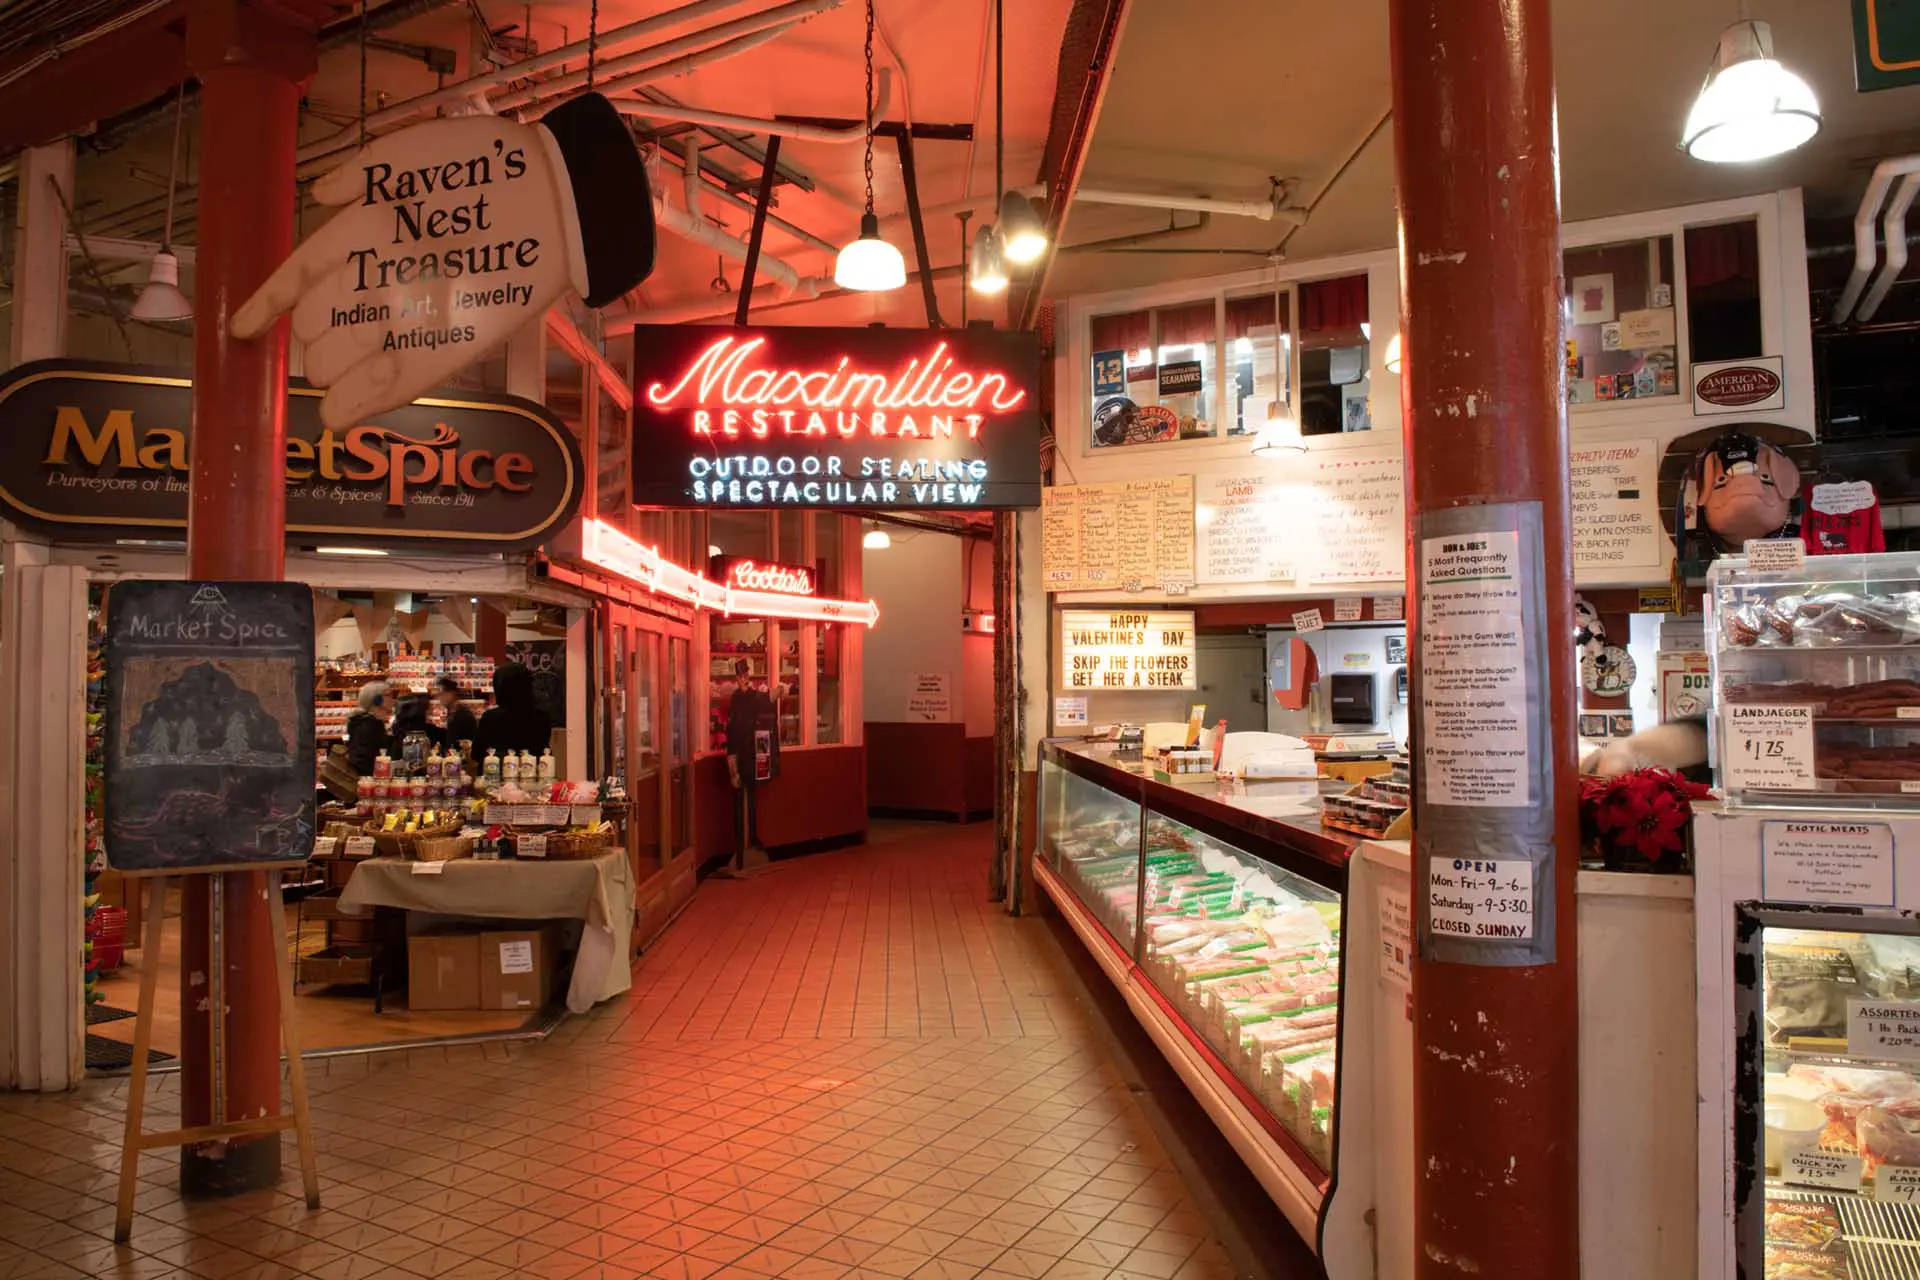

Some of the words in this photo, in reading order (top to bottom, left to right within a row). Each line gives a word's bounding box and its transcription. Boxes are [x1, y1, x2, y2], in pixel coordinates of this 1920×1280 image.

[362, 139, 526, 206] Raven's
[392, 194, 491, 244] Nest
[346, 237, 539, 292] Treasure
[331, 303, 390, 327] Indian
[383, 325, 475, 351] Antiques
[649, 336, 1025, 410] Maximilien
[1161, 373, 1200, 385] SEAHAWKS
[1706, 373, 1769, 387] AMERICAN
[1721, 383, 1754, 393] LAMB
[694, 410, 983, 437] RESTAURANT
[689, 457, 841, 478] OUTDOOR
[861, 457, 988, 480] SEATING
[1571, 465, 1621, 476] EETBREADS
[48, 471, 137, 492] Purveyors
[330, 486, 383, 504] Spices
[411, 490, 450, 505] Since
[692, 480, 897, 501] SPECTACULAR
[913, 482, 983, 503] VIEW
[1225, 485, 1254, 497] LAMB
[1571, 503, 1598, 512] NEYS
[1434, 556, 1454, 565] Most
[1456, 553, 1508, 565] Frequently
[1575, 551, 1625, 561] TTERLINGS
[735, 559, 814, 595] Cocktails
[1430, 567, 1456, 577] Asked
[1457, 566, 1506, 575] Questions
[1110, 615, 1148, 628] HAPPY
[1296, 617, 1320, 631] SUET
[130, 615, 215, 640] Market
[219, 613, 288, 647] Spice
[1474, 632, 1493, 640] Gum
[1163, 631, 1184, 645] DAY
[1073, 656, 1101, 669] SKIP
[1110, 656, 1128, 669] THE
[1134, 655, 1188, 670] FLOWERS
[1072, 672, 1093, 686] GET
[1104, 672, 1124, 686] HER
[1133, 672, 1140, 685] A
[1148, 672, 1184, 685] STEAK
[1476, 700, 1505, 709] original
[1733, 708, 1808, 718] LANDJAEGER
[1786, 824, 1827, 833] EXOTIC
[1831, 825, 1869, 834] MEATS
[1453, 859, 1497, 873] OPEN
[1431, 893, 1474, 915] Saturday
[1432, 918, 1471, 933] CLOSED
[1475, 923, 1526, 938] SUNDAY
[1792, 1158, 1821, 1167] DUCK
